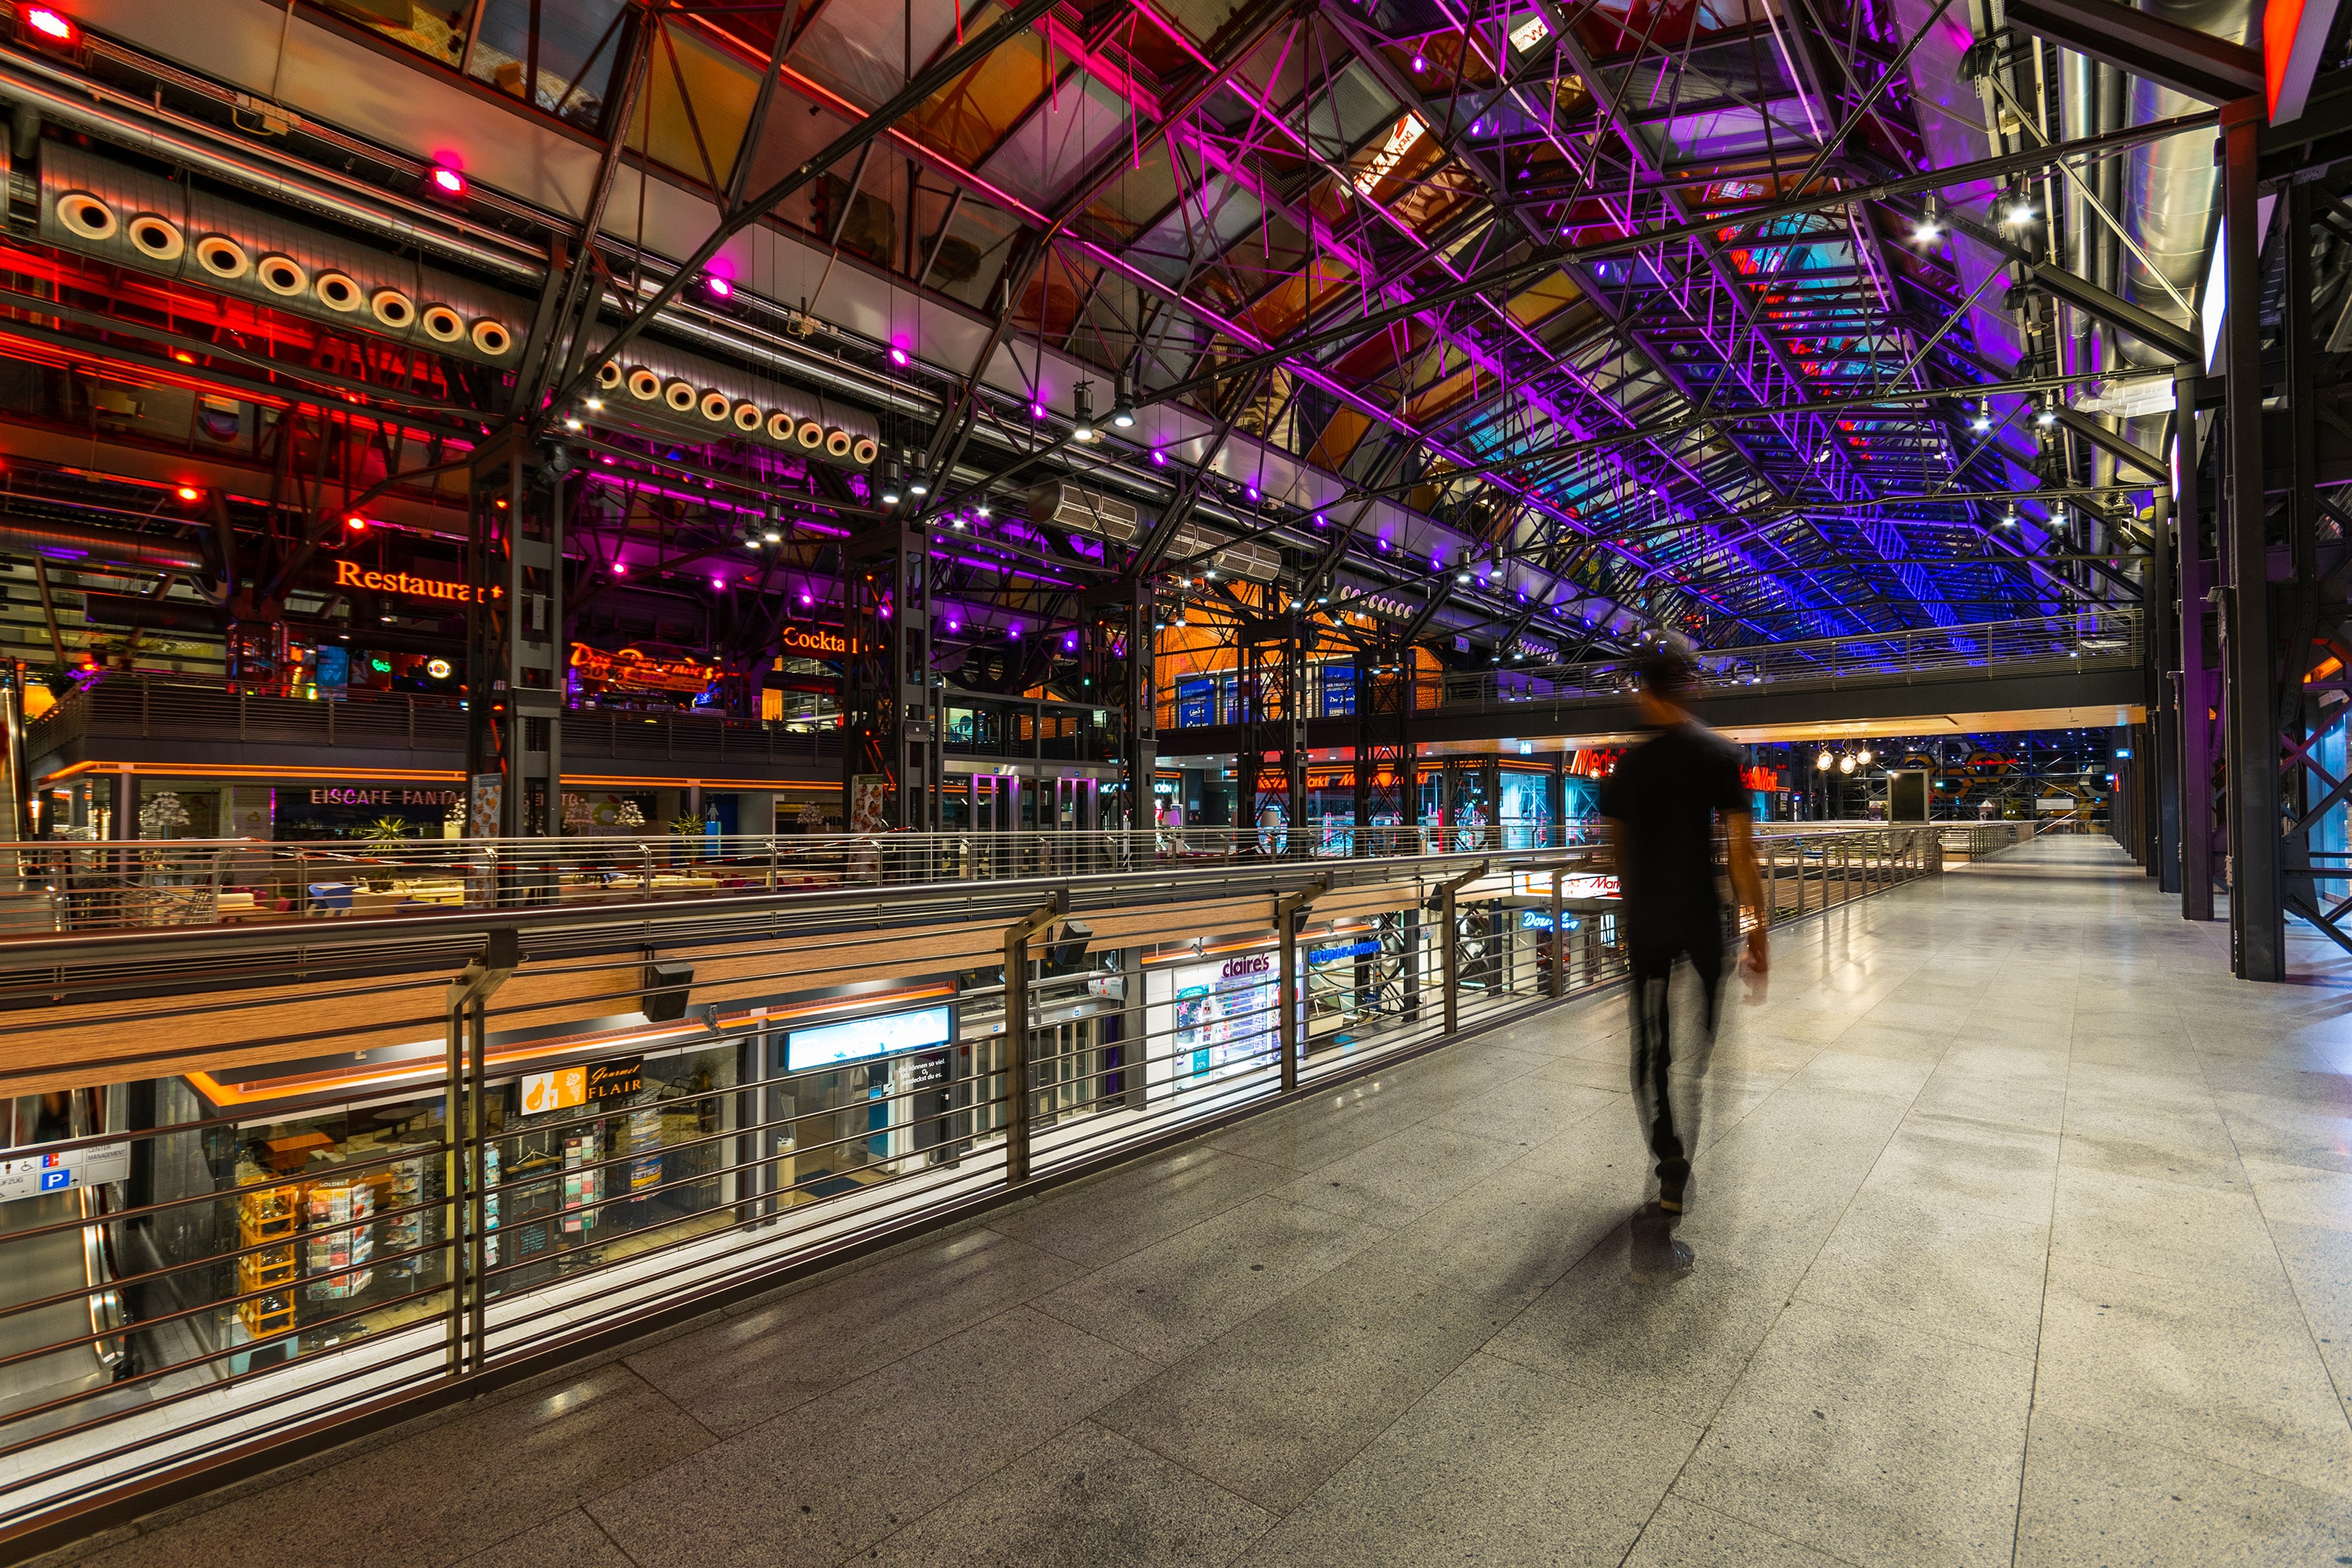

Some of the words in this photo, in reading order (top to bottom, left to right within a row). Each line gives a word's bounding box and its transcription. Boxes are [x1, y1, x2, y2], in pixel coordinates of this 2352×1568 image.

[783, 626, 858, 654] Cocktal
[310, 789, 393, 805] EISCAFE
[1222, 953, 1269, 978] claire's
[590, 1064, 641, 1085] Gourmet
[588, 1080, 641, 1099] FLAIR
[88, 1149, 125, 1161] MANAGEMENT
[48, 1174, 64, 1187] P
